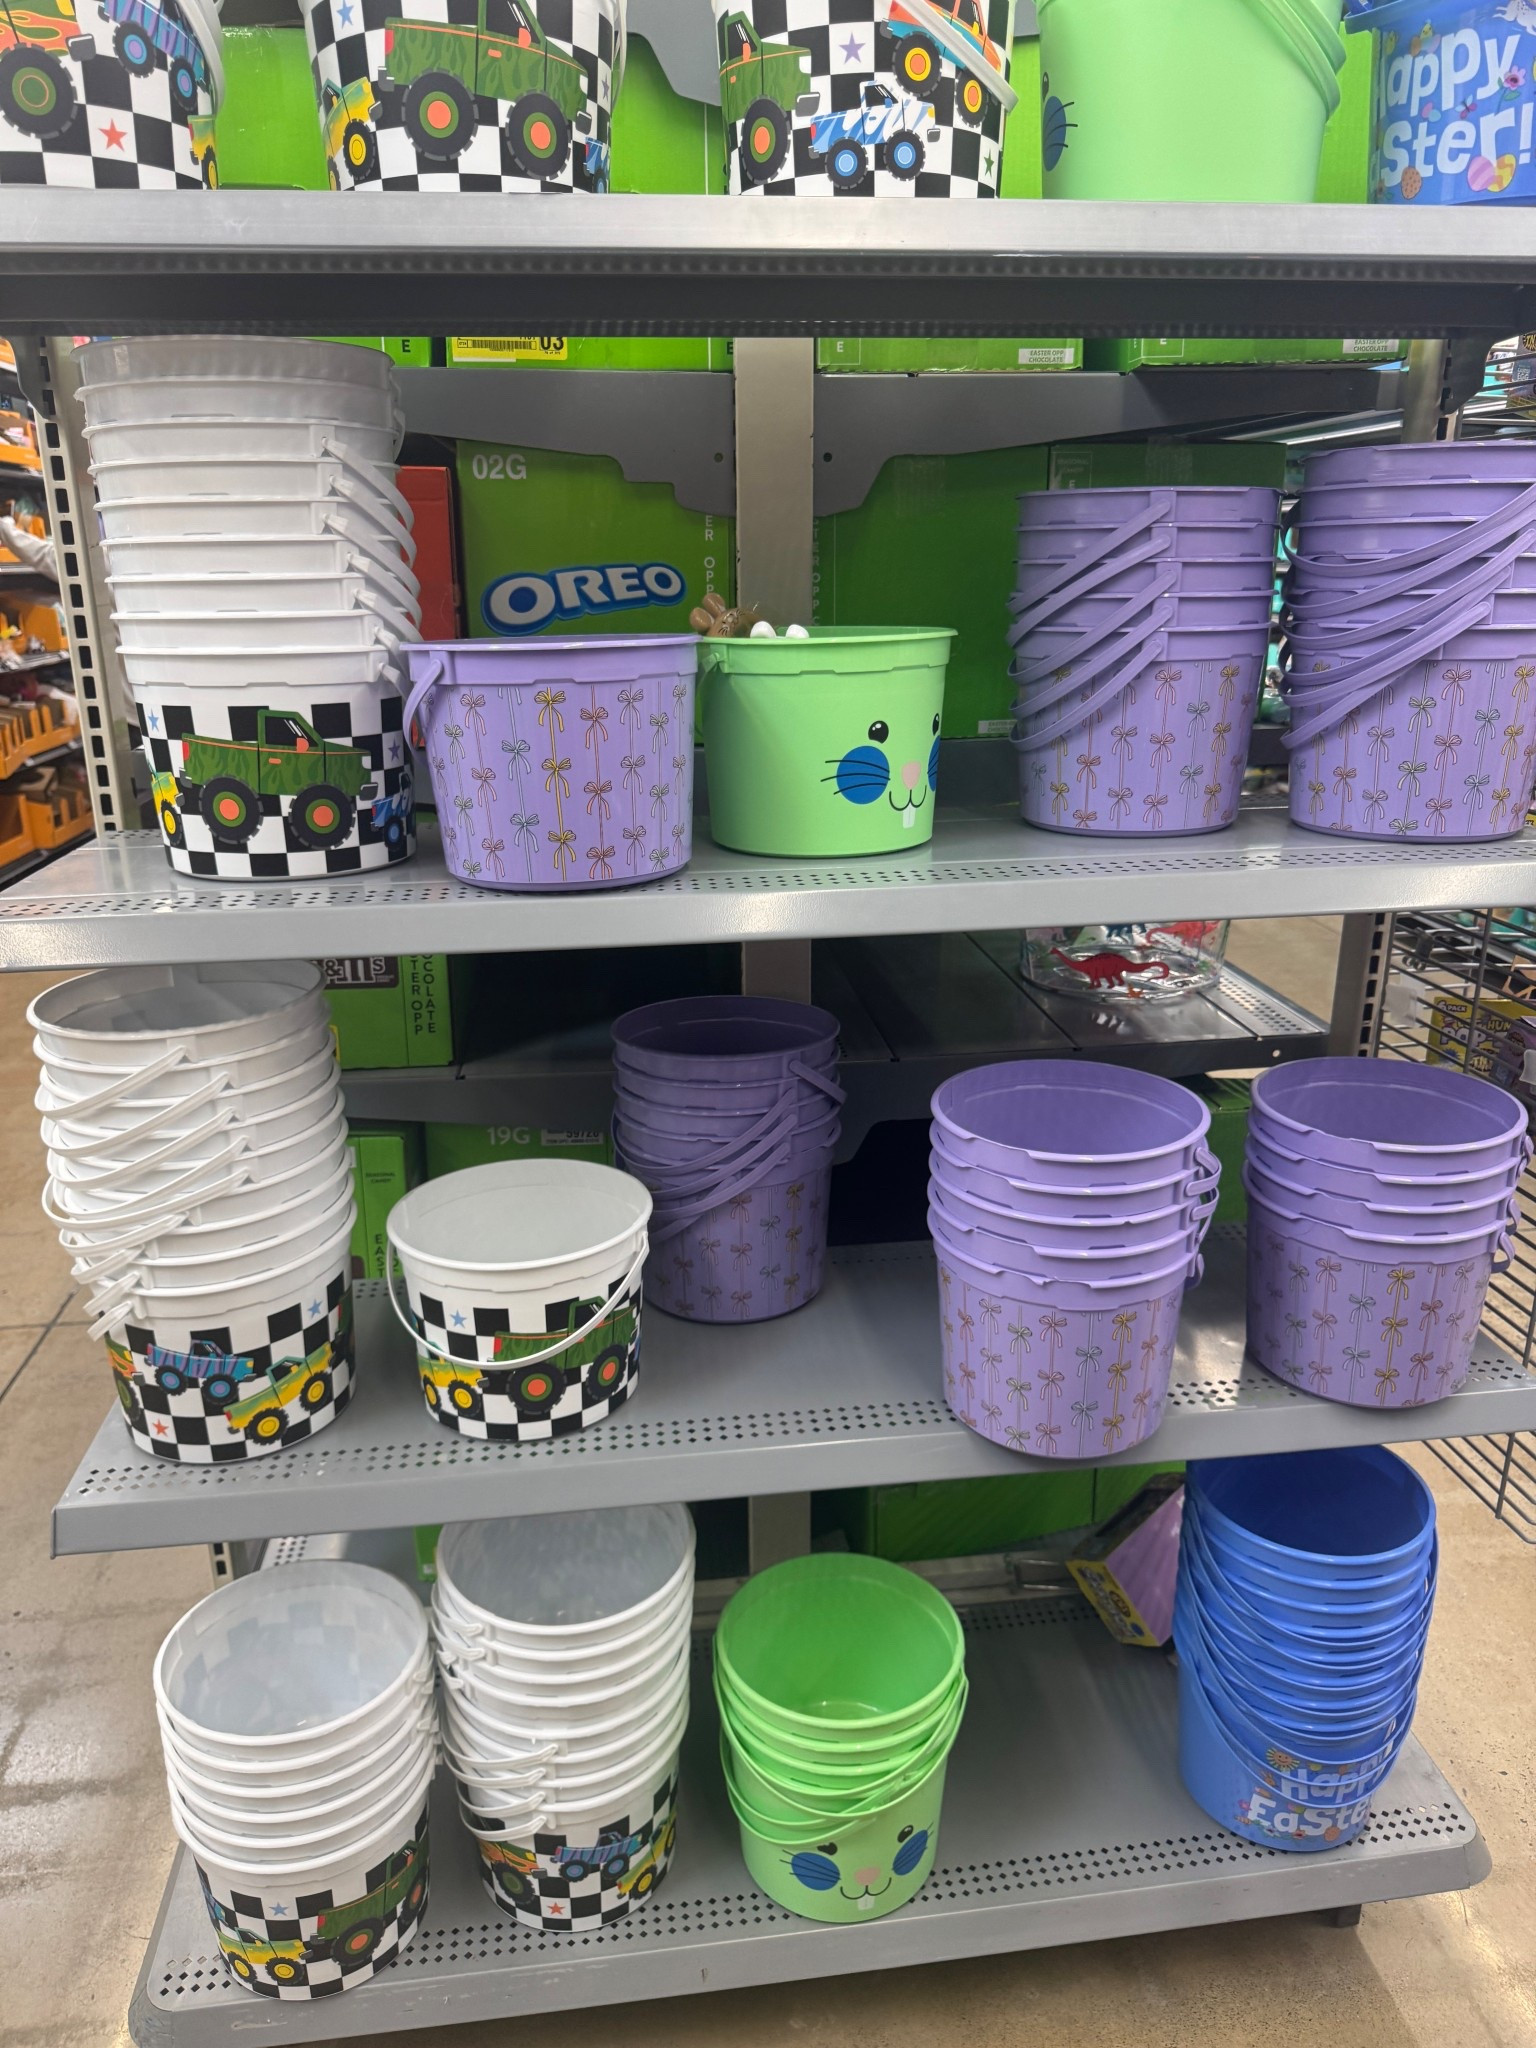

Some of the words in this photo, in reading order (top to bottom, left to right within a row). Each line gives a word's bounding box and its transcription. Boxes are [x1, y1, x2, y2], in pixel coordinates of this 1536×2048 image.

[472, 453, 527, 480] 02G
[489, 565, 683, 626] OREO
[1447, 1004, 1468, 1013] PACK
[487, 1126, 531, 1146] 19G
[374, 1233, 386, 1279] EAST
